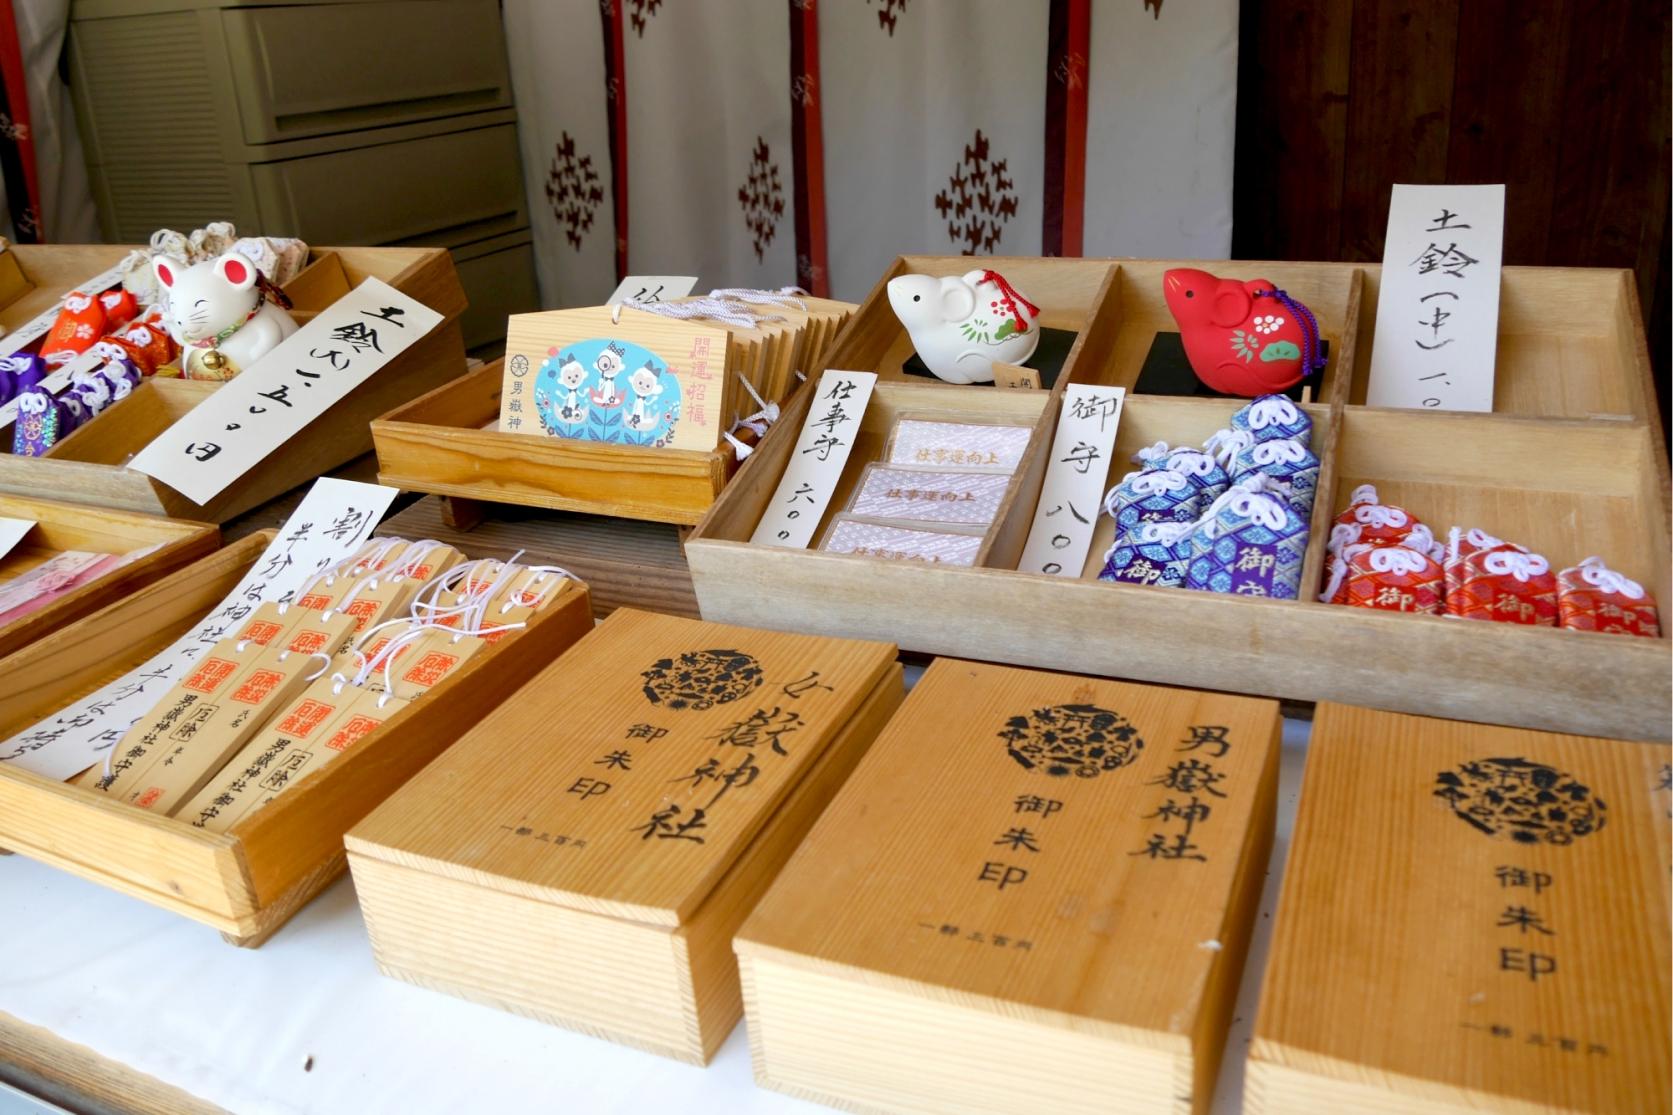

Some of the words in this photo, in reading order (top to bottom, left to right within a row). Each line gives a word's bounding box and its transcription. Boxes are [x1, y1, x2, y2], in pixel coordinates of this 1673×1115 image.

[686, 337, 713, 427] 開運招福
[803, 380, 857, 461] 仕事守
[916, 448, 1000, 465] 仕事運向上
[1062, 396, 1118, 473] 御守
[886, 488, 976, 503] 仕事運向上
[567, 723, 669, 800] 御朱印
[1127, 725, 1231, 862] 男嶽神社
[977, 793, 1063, 890] 御朱印
[1495, 865, 1557, 982] 御朱印
